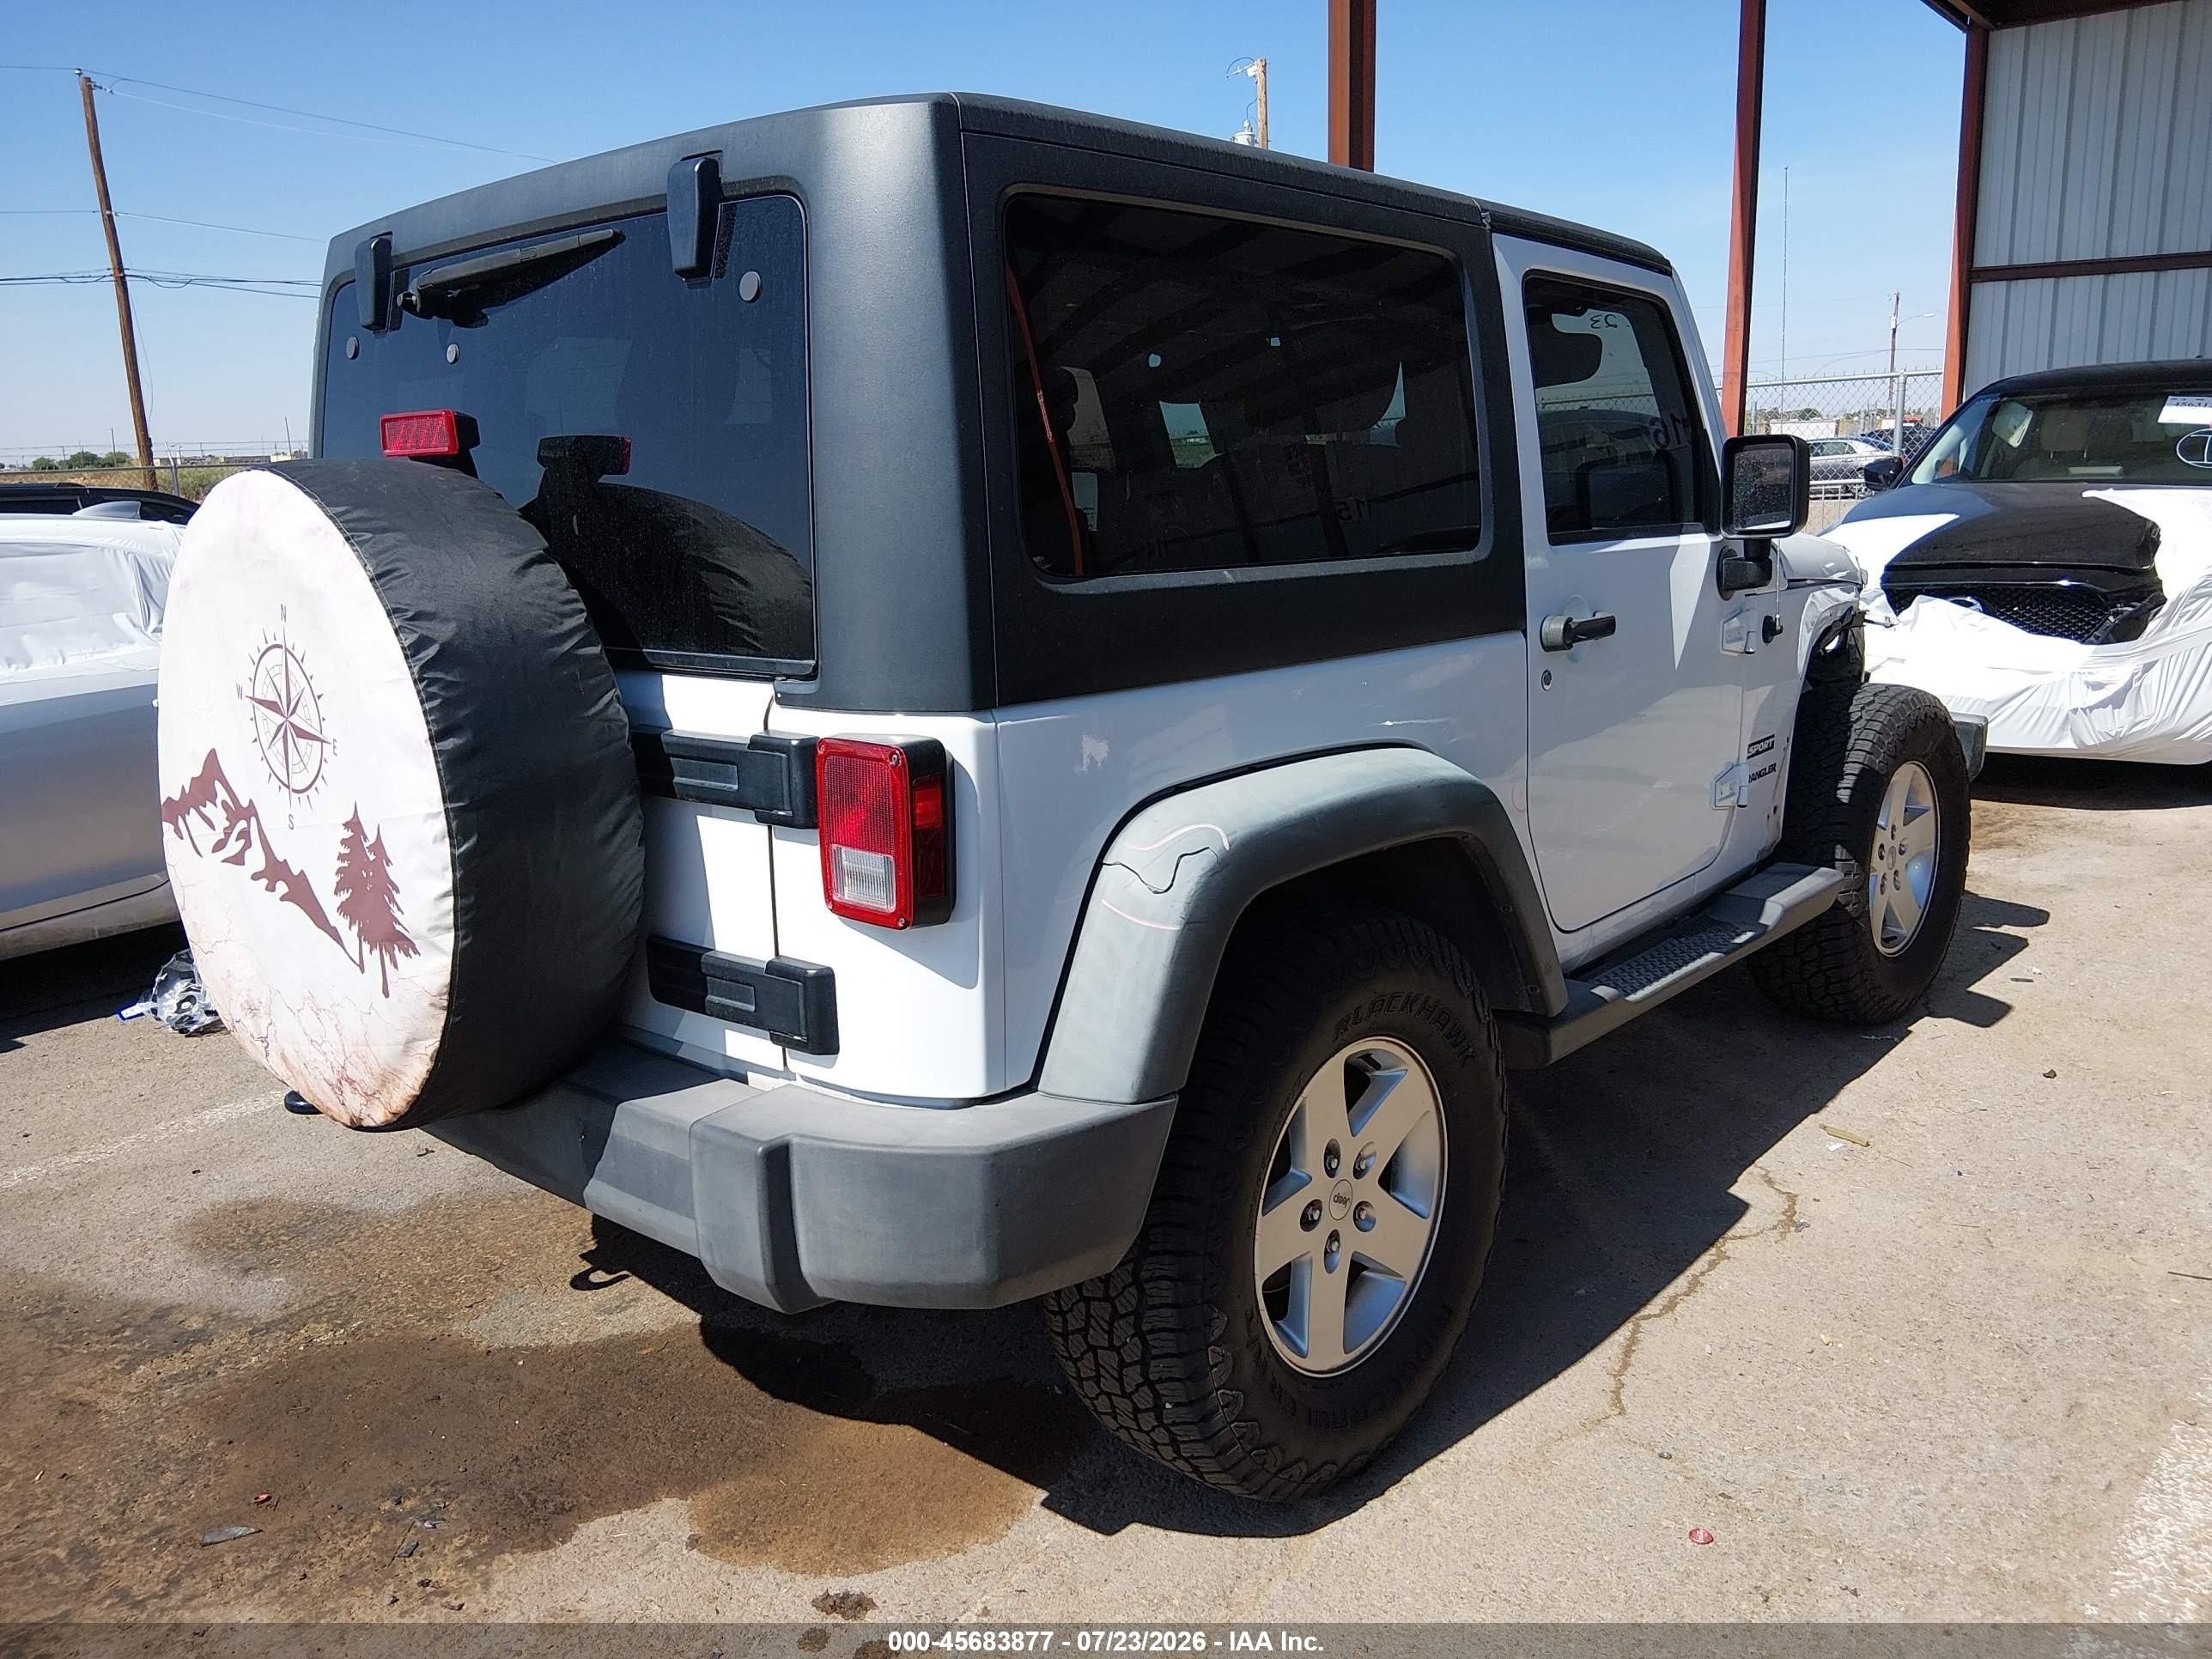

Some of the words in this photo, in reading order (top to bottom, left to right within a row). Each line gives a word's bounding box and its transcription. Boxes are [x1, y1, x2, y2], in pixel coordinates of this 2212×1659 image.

[281, 604, 287, 623] N
[236, 683, 243, 701] W
[332, 738, 337, 756] E
[1748, 738, 1775, 754] SPORT
[1748, 763, 1777, 783] ANGLER
[289, 813, 295, 830] S
[1333, 1193, 1350, 1208] Jeep
